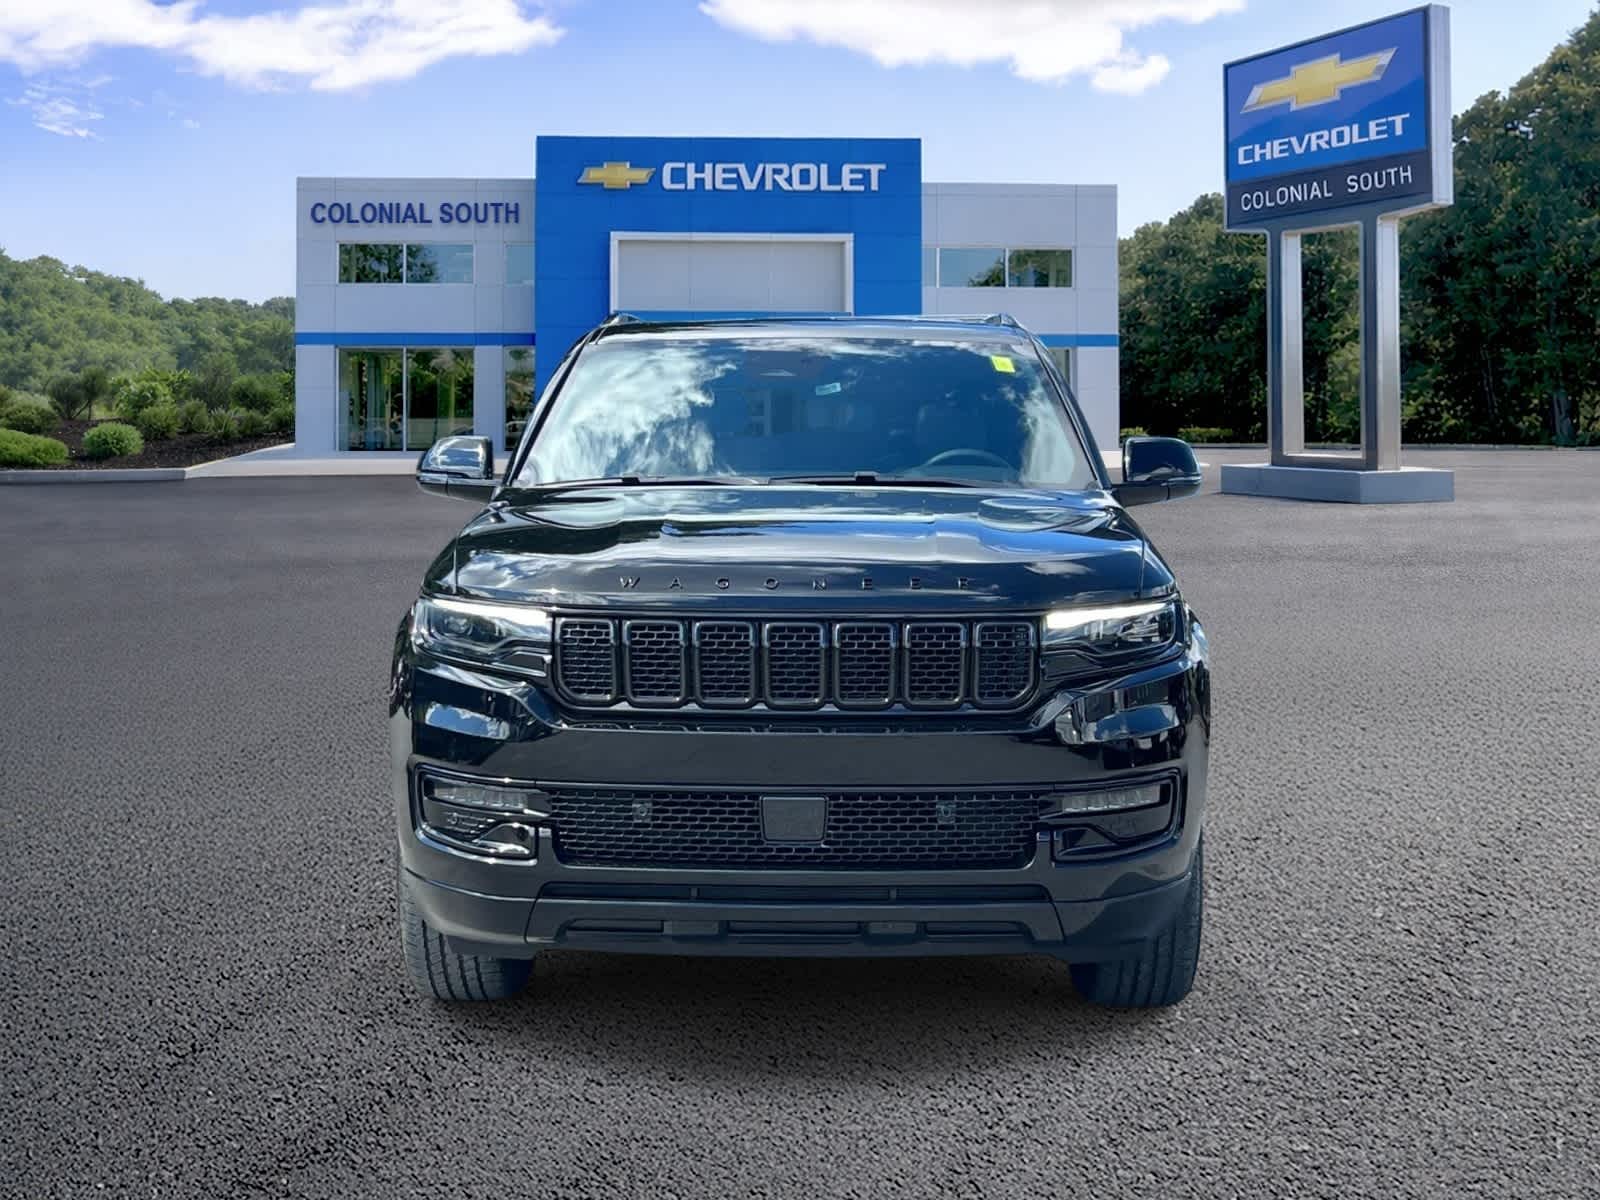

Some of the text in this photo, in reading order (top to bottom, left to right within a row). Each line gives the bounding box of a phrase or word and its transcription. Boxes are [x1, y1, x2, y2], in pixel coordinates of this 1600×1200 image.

[1237, 113, 1410, 165] CHEVROLET
[661, 161, 887, 192] CHEVROLET
[1240, 165, 1413, 211] COLONIAL SOUTH
[310, 202, 521, 225] COLONIAL SOUTH
[619, 576, 975, 591] WAGONEER
